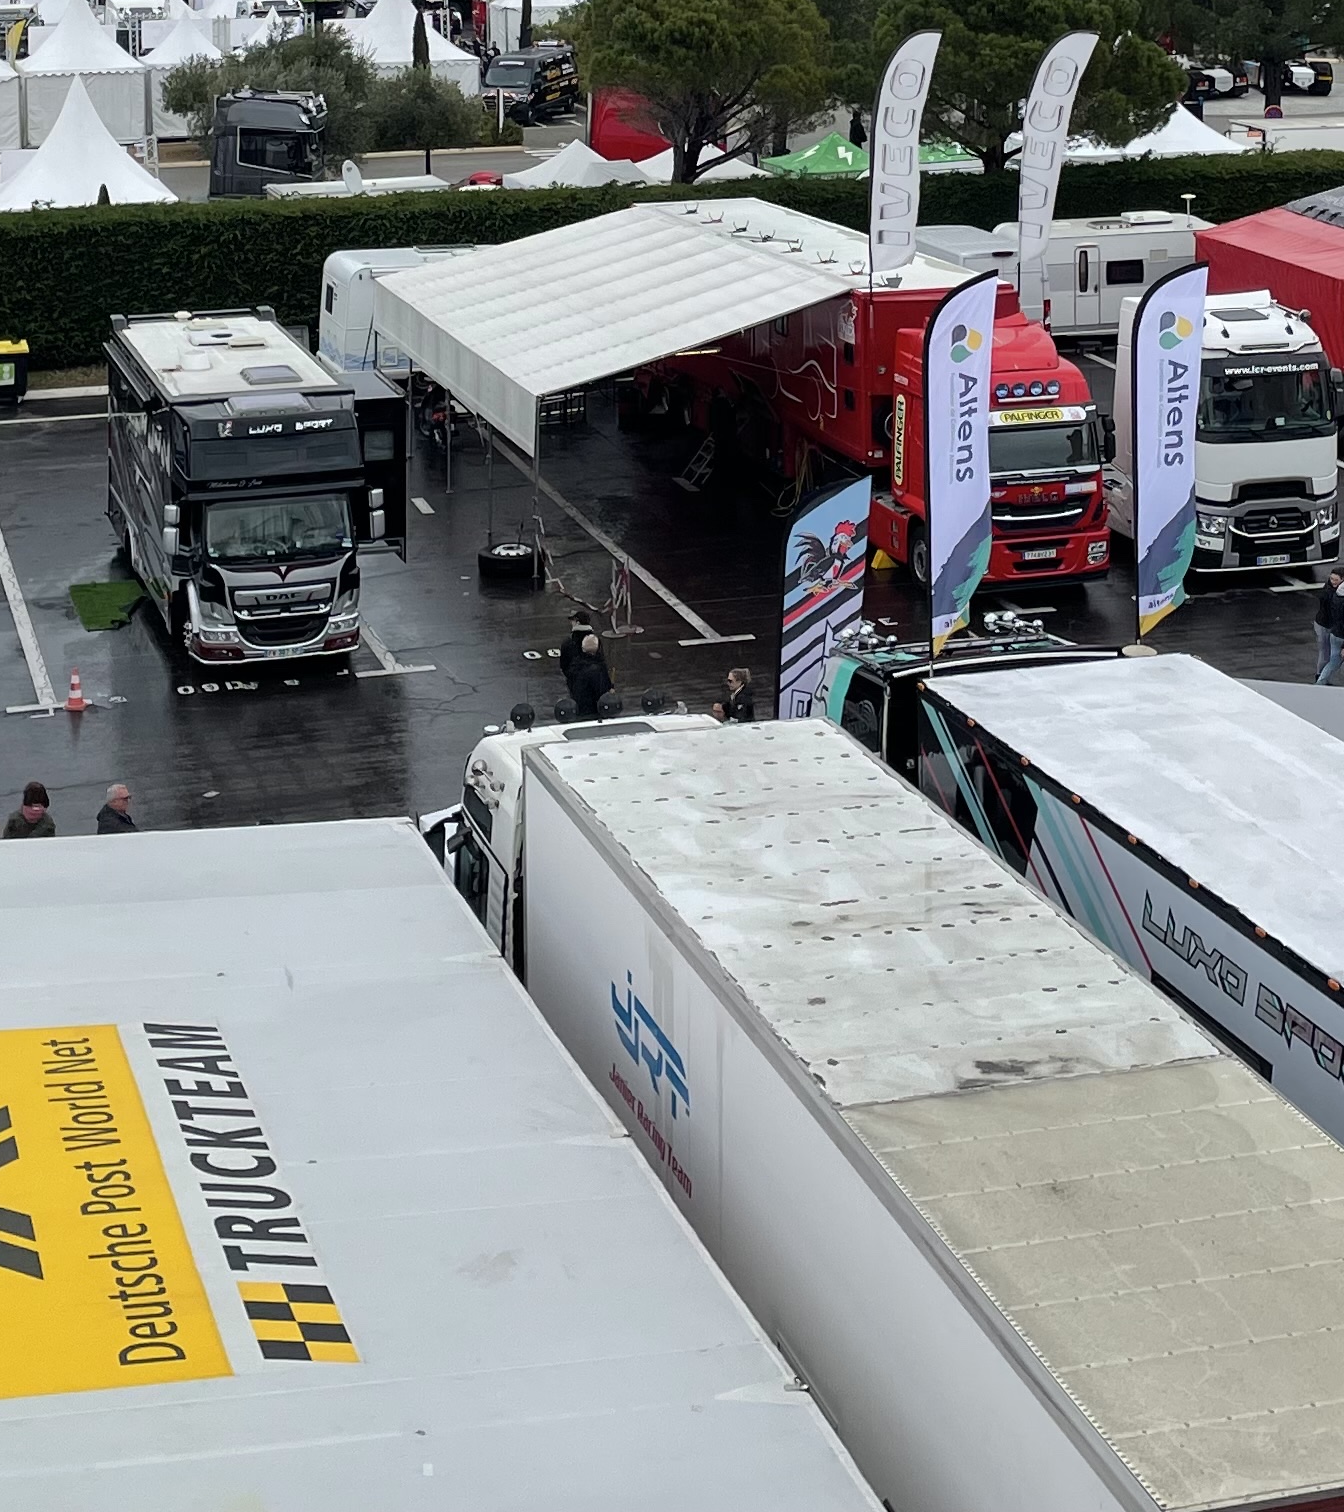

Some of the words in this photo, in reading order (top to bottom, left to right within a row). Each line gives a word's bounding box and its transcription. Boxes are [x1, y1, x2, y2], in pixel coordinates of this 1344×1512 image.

[876, 59, 926, 246] IVECO
[1020, 56, 1078, 239] IVECO
[895, 400, 904, 480] PALFINGER
[956, 372, 978, 483] Altens
[1004, 410, 1059, 422] PALFINGER
[1164, 359, 1189, 467] Altens
[265, 593, 302, 601] DAF
[1142, 888, 1248, 1007] LUXO
[42, 1036, 99, 1074] Net
[44, 1079, 121, 1151] World
[142, 1022, 318, 1271] TRUCKTEAM
[637, 1099, 665, 1162] Racing
[667, 1142, 692, 1199] Team
[73, 1158, 142, 1216] Post
[88, 1222, 187, 1365] Deutsche
